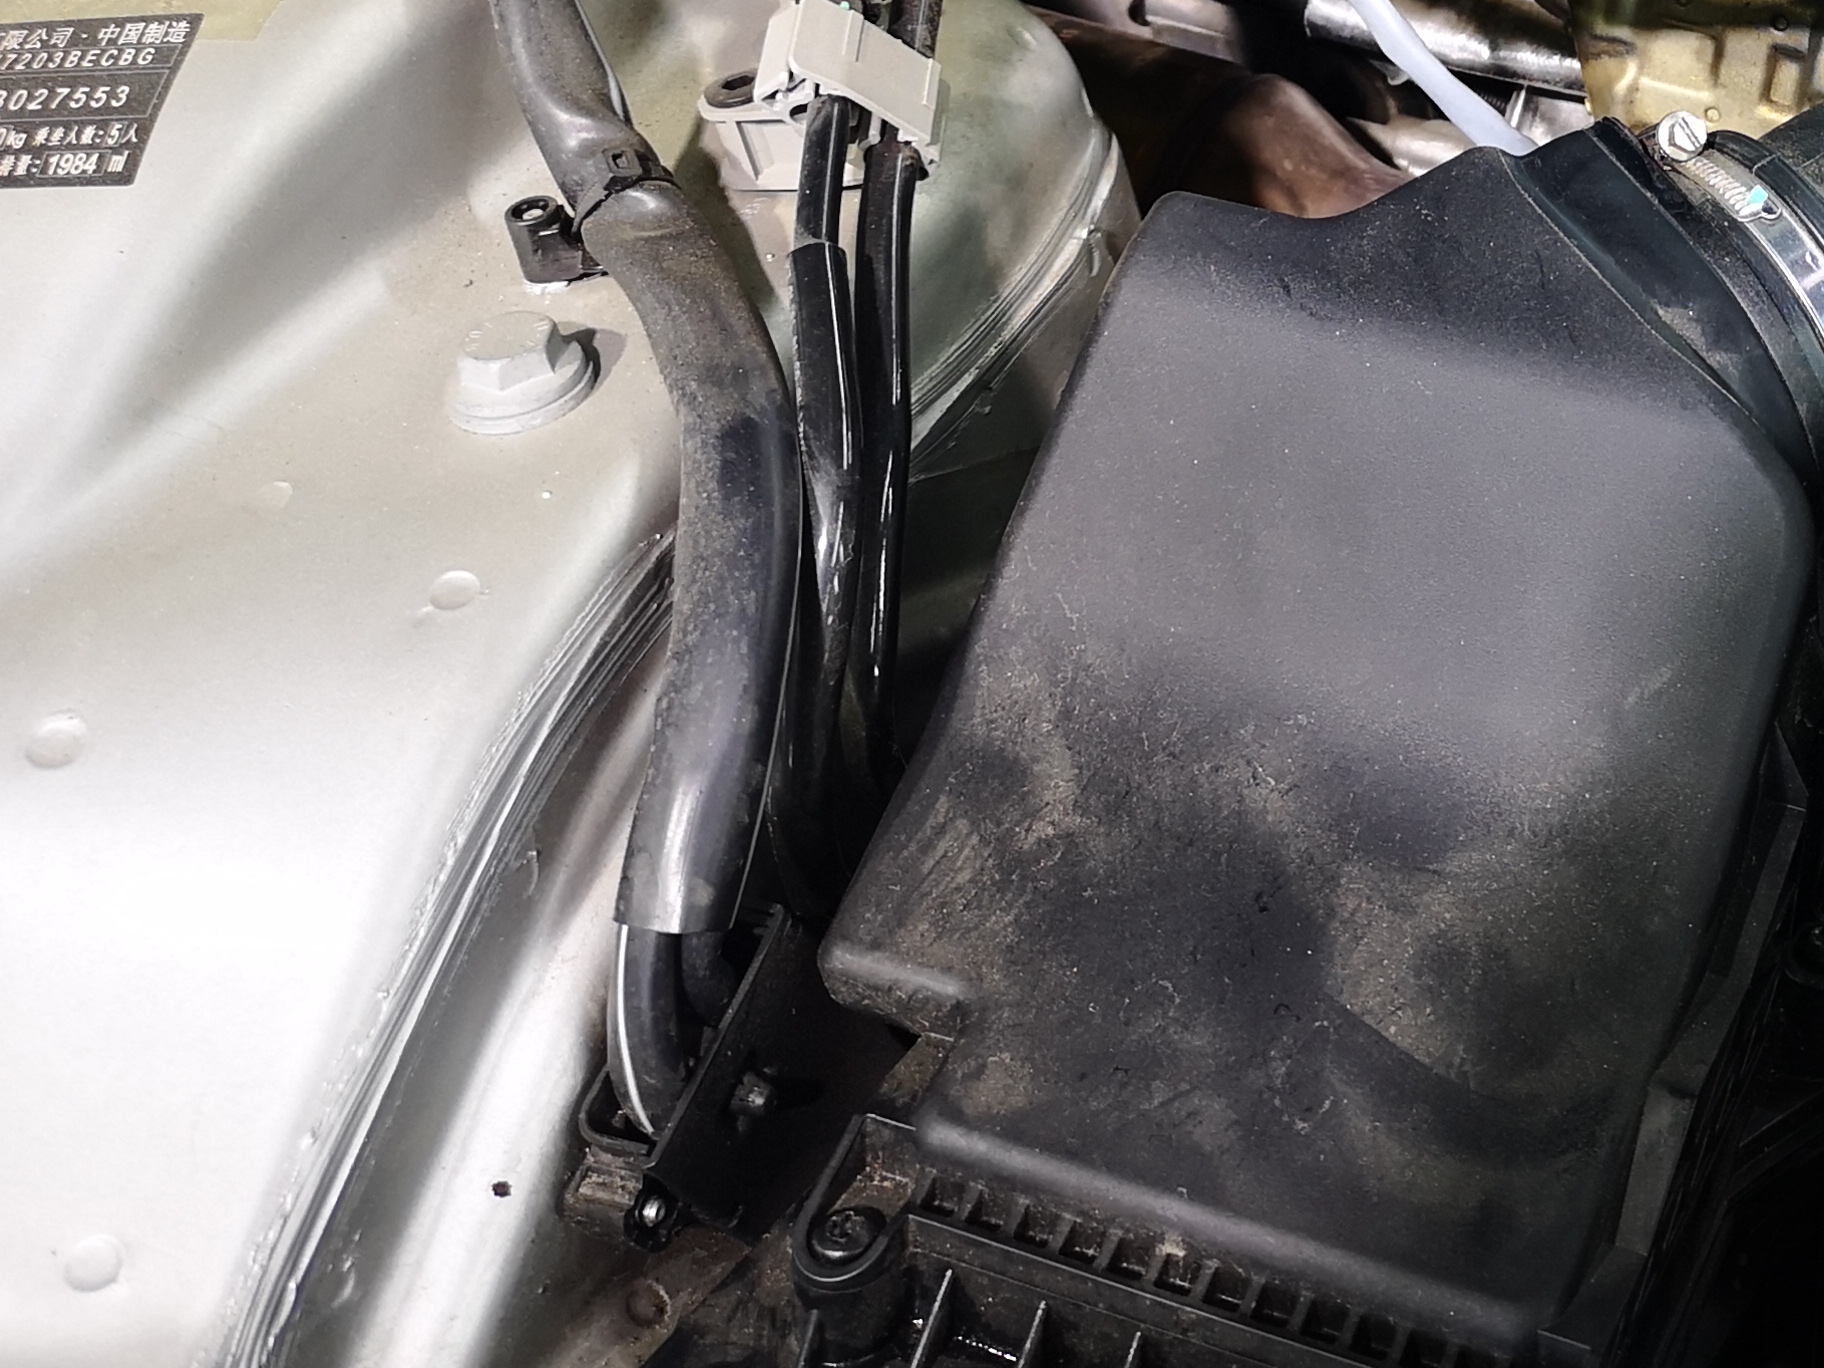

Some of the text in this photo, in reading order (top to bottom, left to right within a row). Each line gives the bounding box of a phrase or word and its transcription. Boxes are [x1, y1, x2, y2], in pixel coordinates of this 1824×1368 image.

[97, 20, 191, 46] 中国制造
[47, 152, 100, 175] 1984
